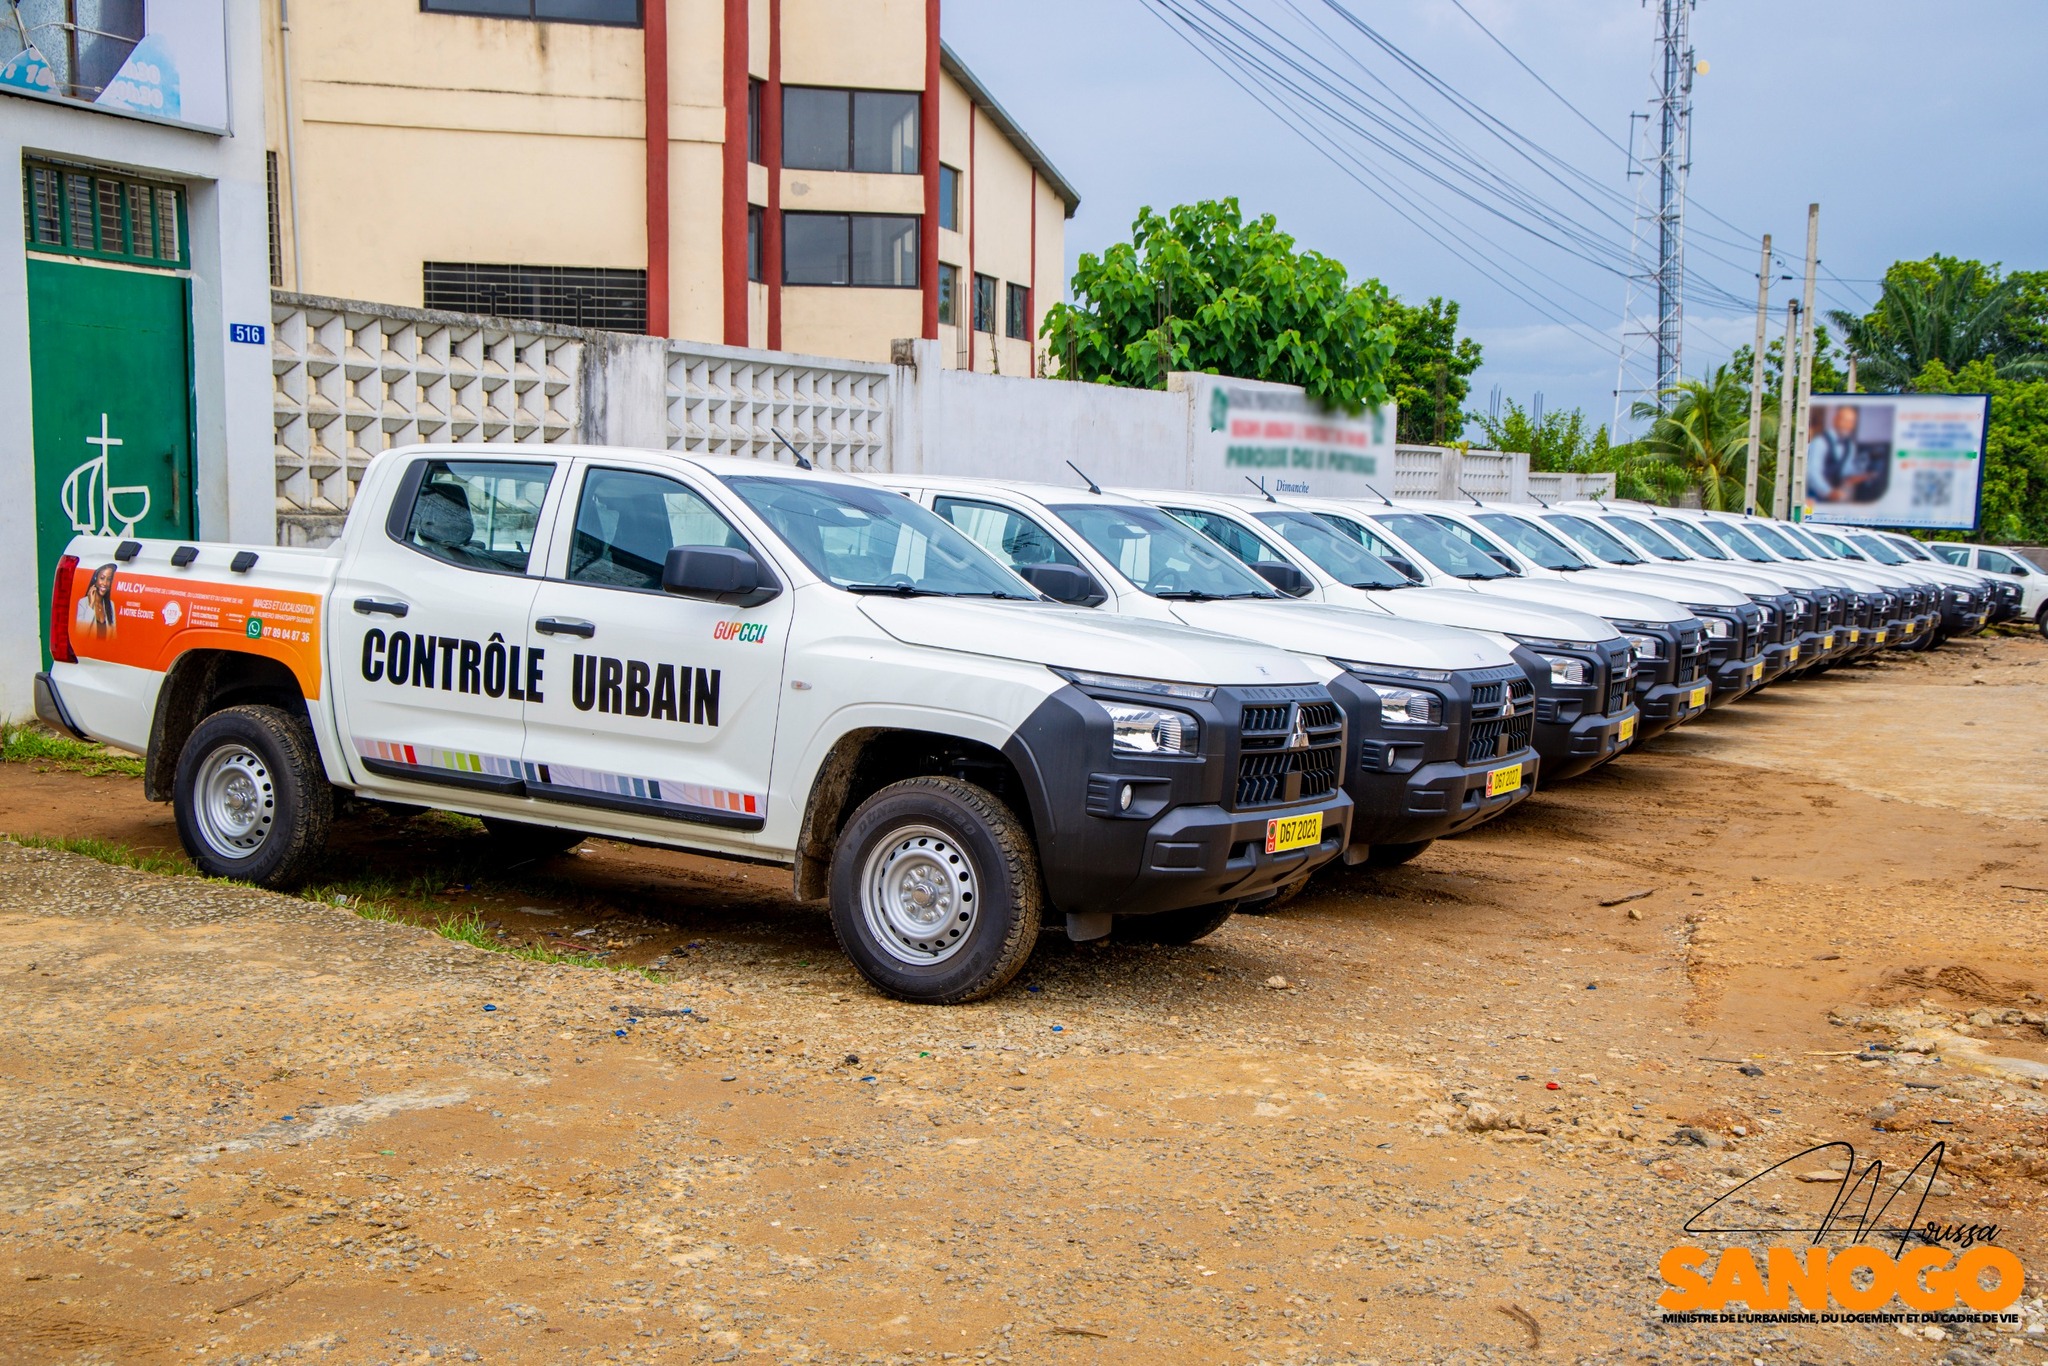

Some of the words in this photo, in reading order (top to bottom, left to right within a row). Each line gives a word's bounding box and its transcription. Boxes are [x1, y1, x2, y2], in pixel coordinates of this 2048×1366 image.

[236, 325, 260, 342] 516
[1276, 479, 1309, 493] Dimanche
[116, 581, 146, 594] MULCV
[123, 607, 138, 617] VOTRE
[263, 626, 272, 637] 07
[281, 629, 291, 640] 04
[291, 630, 301, 641] 87
[301, 631, 311, 643] 36
[713, 621, 768, 643] GUPCCU
[361, 628, 545, 703] CONTRÔLE
[572, 653, 721, 727] URBAIN
[1280, 821, 1297, 843] D67
[1297, 818, 1316, 840] 2023
